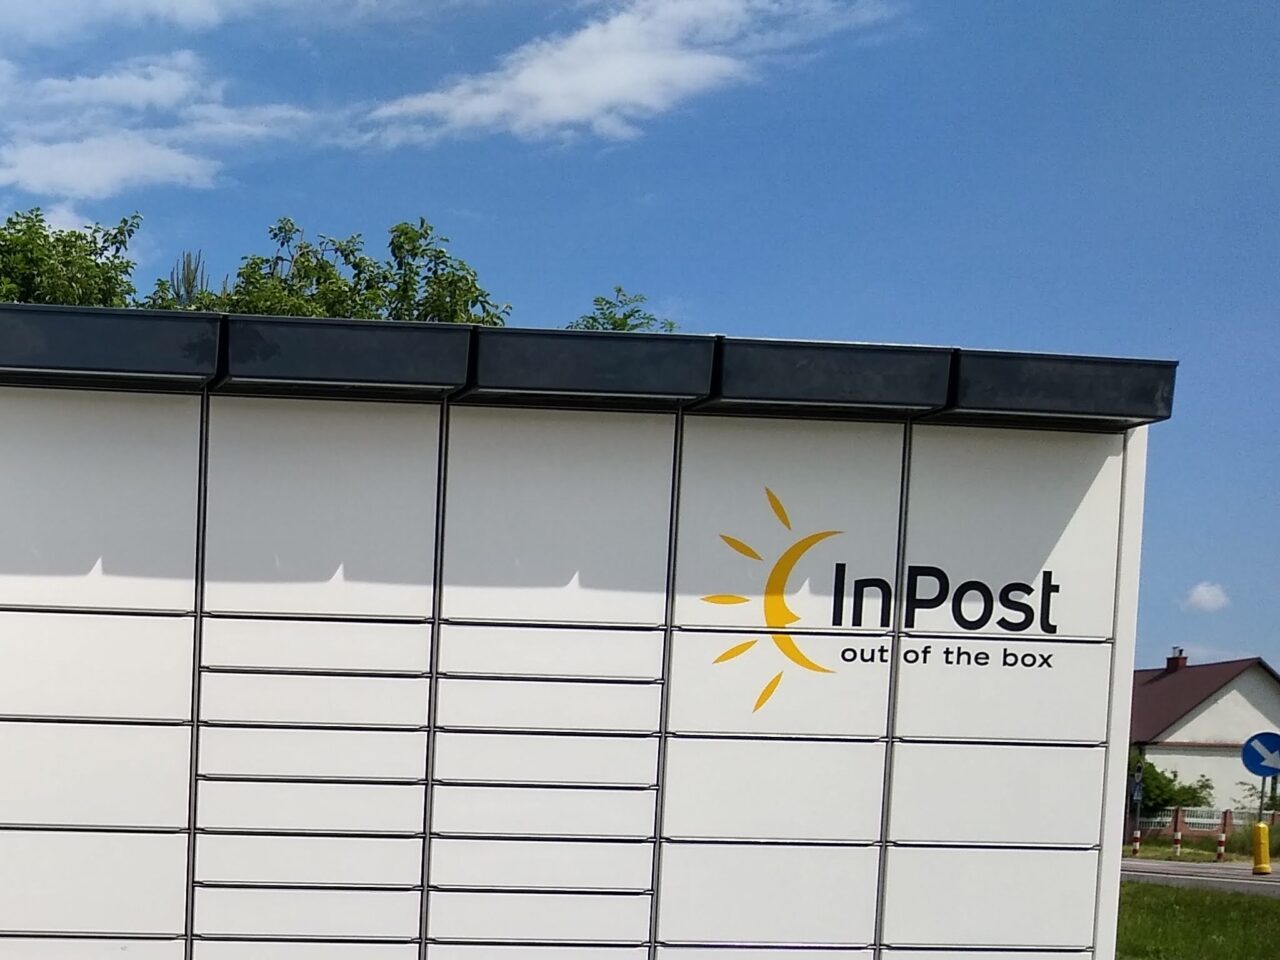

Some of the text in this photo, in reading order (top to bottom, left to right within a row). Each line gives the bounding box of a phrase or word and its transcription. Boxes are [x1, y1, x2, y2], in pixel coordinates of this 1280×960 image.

[832, 562, 1060, 634] InPost
[840, 645, 1054, 668] out of the box
